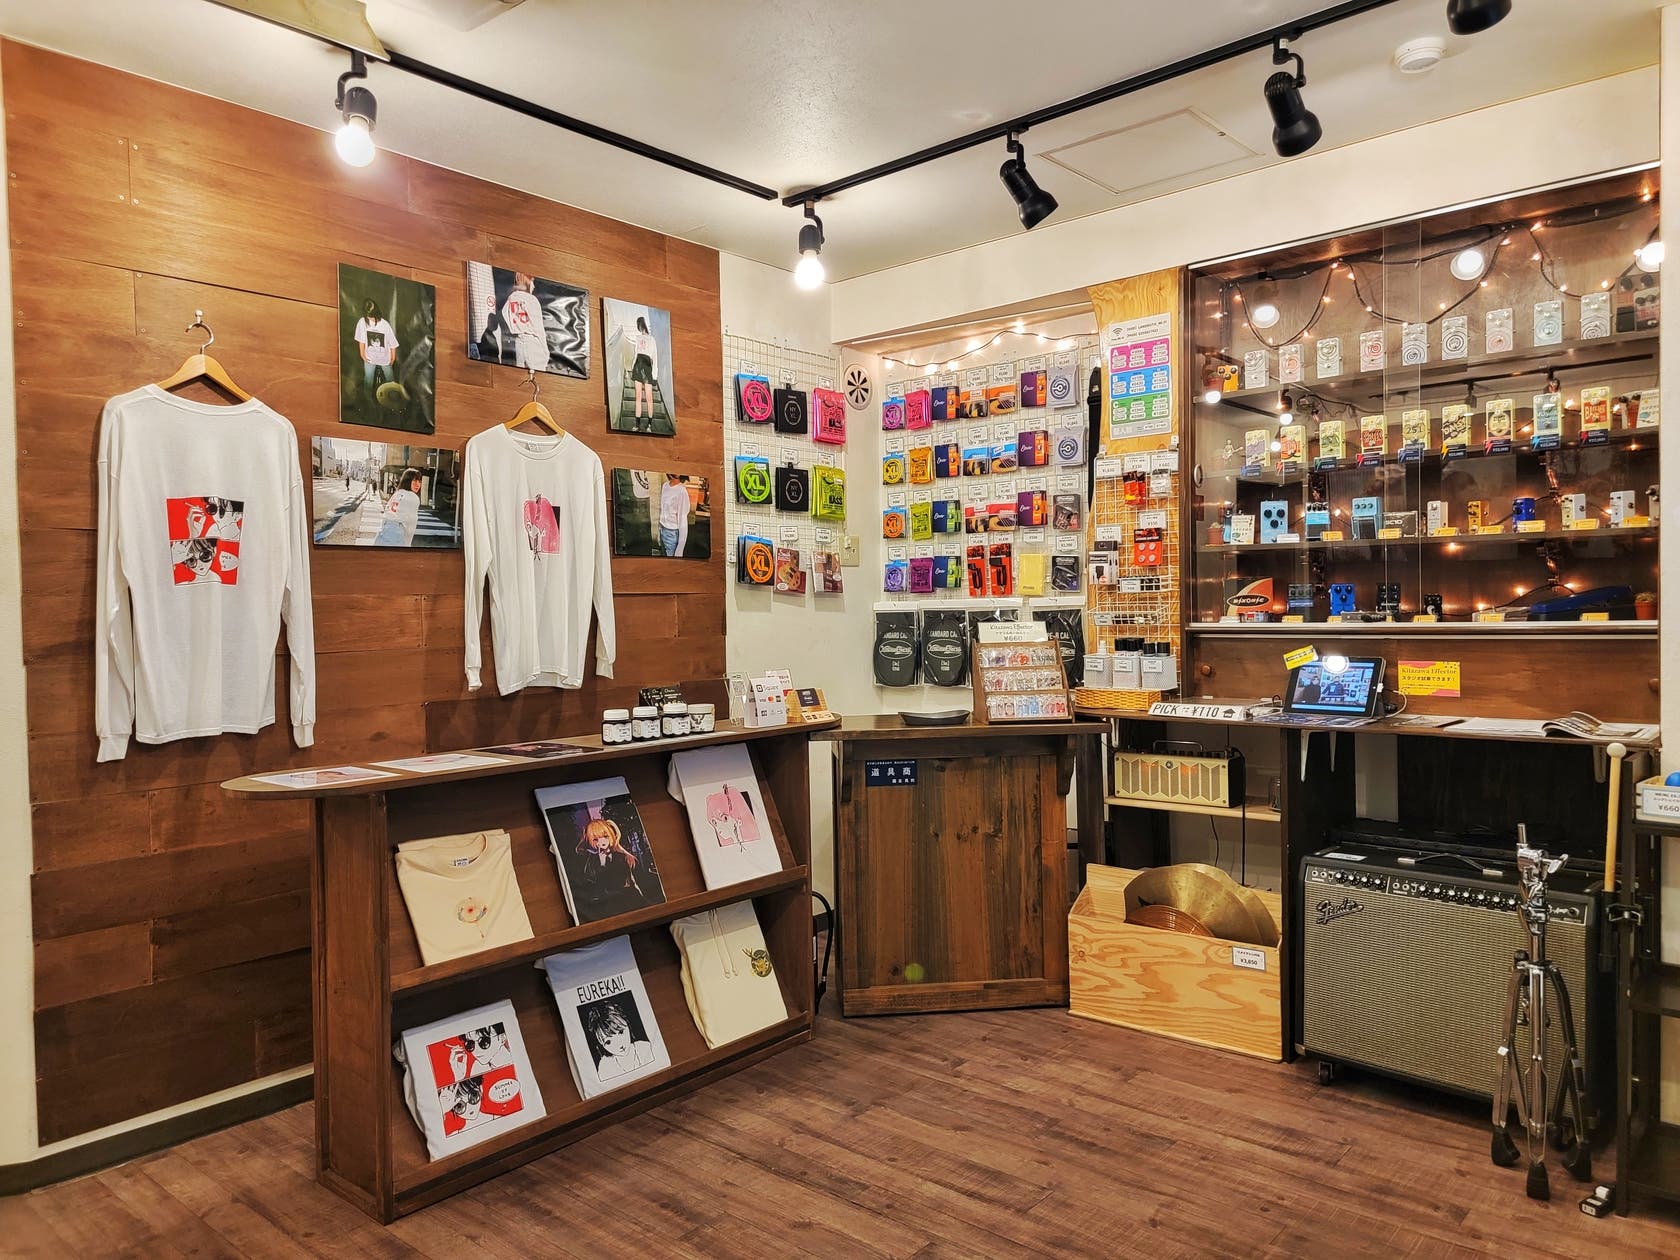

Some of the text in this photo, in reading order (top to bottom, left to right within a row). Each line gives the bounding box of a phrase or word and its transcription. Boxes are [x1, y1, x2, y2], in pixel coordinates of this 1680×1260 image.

[746, 473, 765, 491] XL
[753, 554, 769, 572] XL
[1152, 703, 1219, 718] PICK ¥110
[871, 767, 911, 777] 道具商
[1316, 897, 1364, 925] Fender
[576, 974, 626, 1004] EUREKA!!
